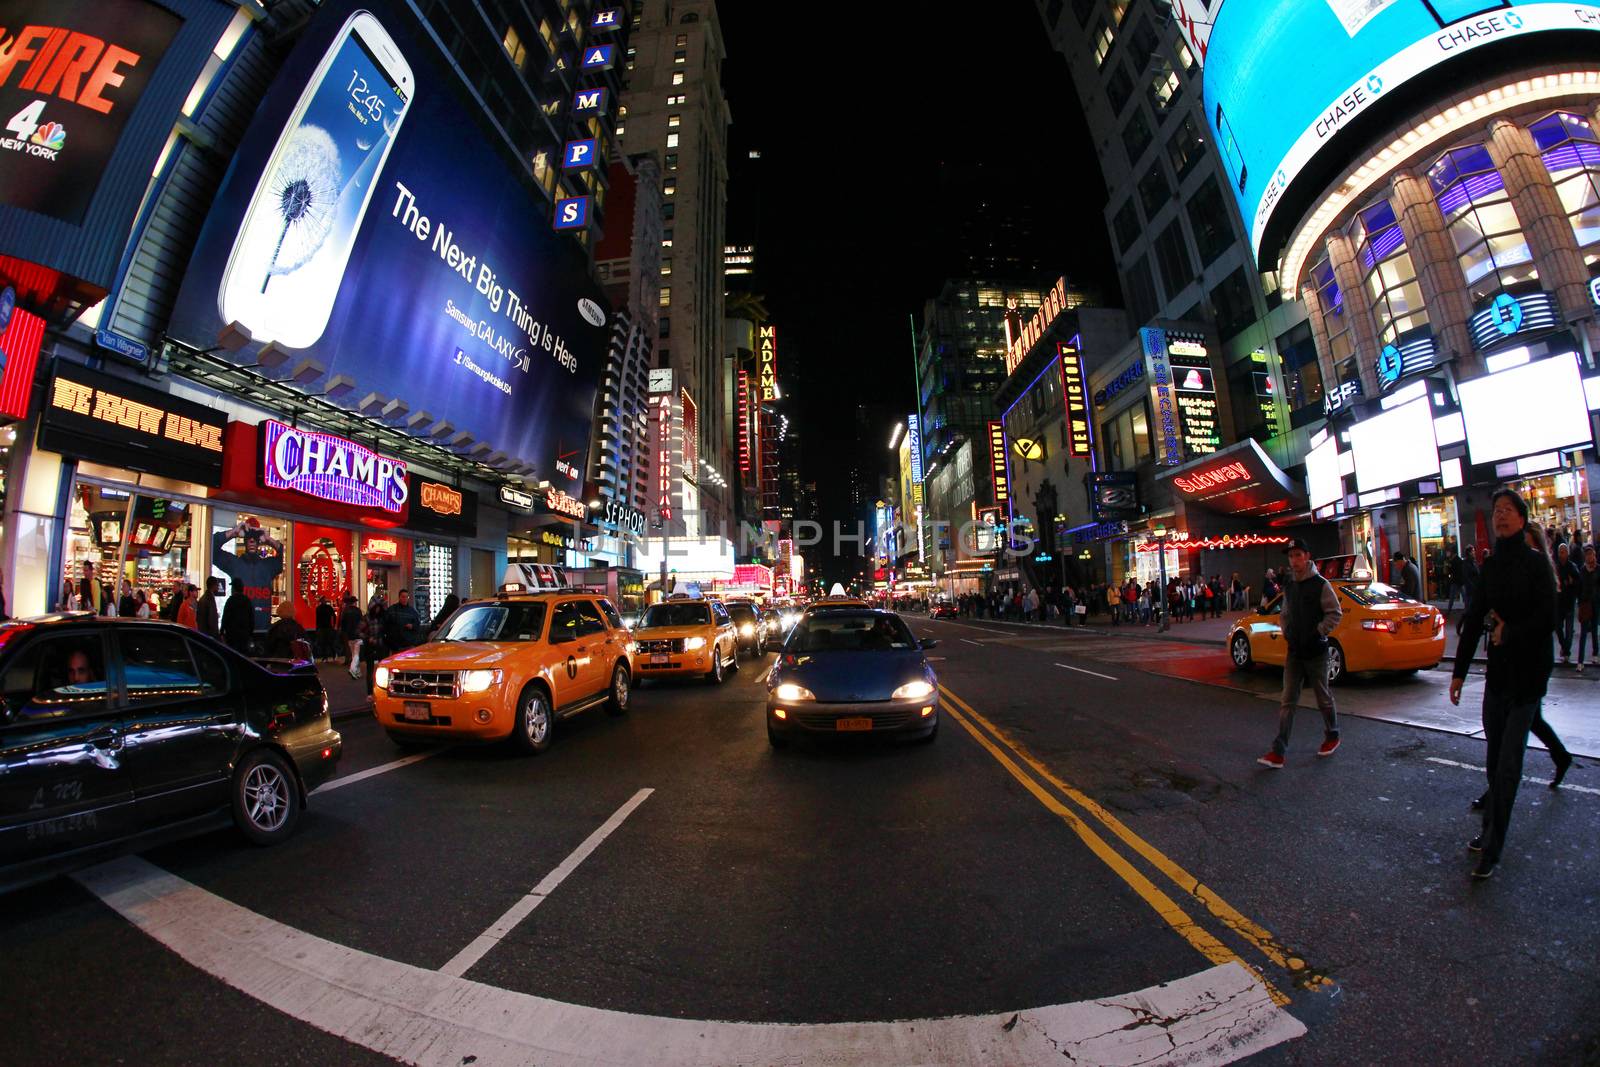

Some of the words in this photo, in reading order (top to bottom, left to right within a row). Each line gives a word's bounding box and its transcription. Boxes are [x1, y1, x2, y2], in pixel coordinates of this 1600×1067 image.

[1437, 16, 1505, 52] CHASE
[0, 24, 141, 115] FIRE
[347, 69, 386, 122] 12:45
[1315, 89, 1367, 138] CHASE
[5, 99, 47, 141] 4
[0, 137, 25, 151] NEW
[25, 142, 59, 162] YORK
[1258, 182, 1279, 226] CHASE
[392, 181, 431, 241] The
[432, 222, 476, 283] Next
[476, 264, 503, 313] Big
[506, 289, 541, 346] Thing
[541, 324, 552, 352] Is
[553, 336, 577, 374] Here
[101, 332, 116, 346] Van
[117, 338, 144, 357] Wagner
[445, 299, 477, 337] Samsung
[477, 320, 515, 361] GALAXY
[760, 326, 774, 400] MADAME
[1062, 346, 1084, 411] VICTORY
[908, 414, 918, 430] NEW
[1072, 420, 1089, 453] NEW
[275, 429, 409, 505] CHAMPS
[991, 424, 1005, 471] VICTORY
[1192, 445, 1201, 453] To
[556, 459, 579, 480] verizon
[996, 476, 1008, 500] NEW
[1174, 462, 1251, 493] Subway
[423, 487, 460, 511] CHAMPS
[605, 501, 648, 534] SEPHORA
